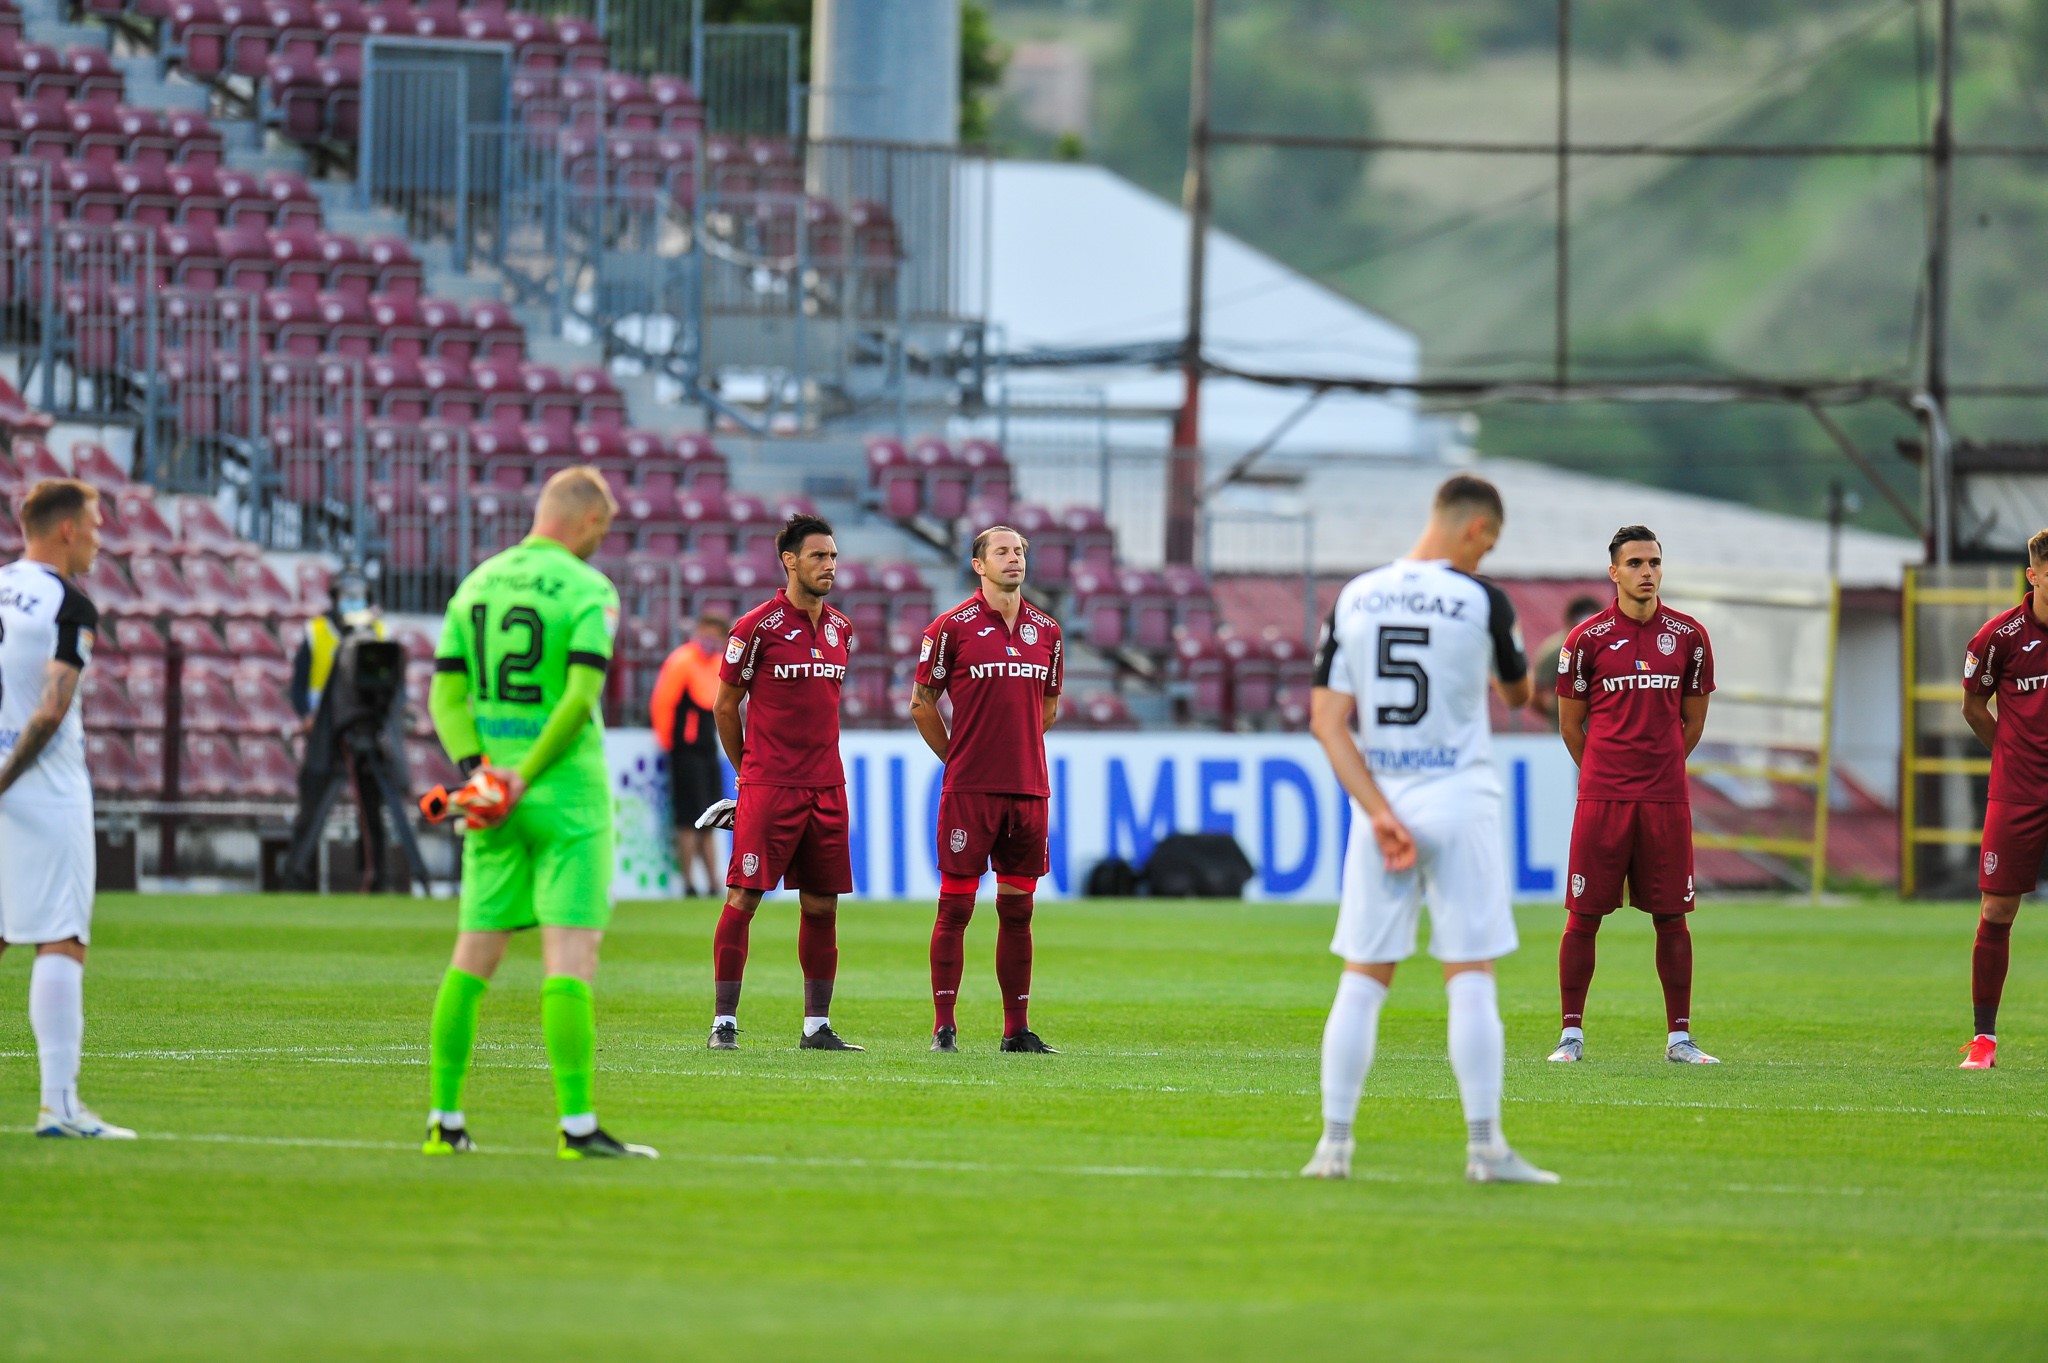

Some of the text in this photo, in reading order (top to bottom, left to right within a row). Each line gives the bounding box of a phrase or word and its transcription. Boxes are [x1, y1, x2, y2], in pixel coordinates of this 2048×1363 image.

[758, 608, 786, 630] TORRY
[950, 604, 980, 622] TORRY
[1025, 607, 1056, 628] TORRY
[1583, 618, 1616, 637] TORRY
[1661, 615, 1695, 635] TORRY
[1996, 615, 2026, 637] TORRY
[471, 604, 543, 703] 12
[937, 632, 949, 667] Autoworld
[774, 663, 812, 679] NTT
[970, 662, 1007, 679] NTT
[1377, 625, 1429, 725] 5
[1602, 675, 1637, 692] NTT
